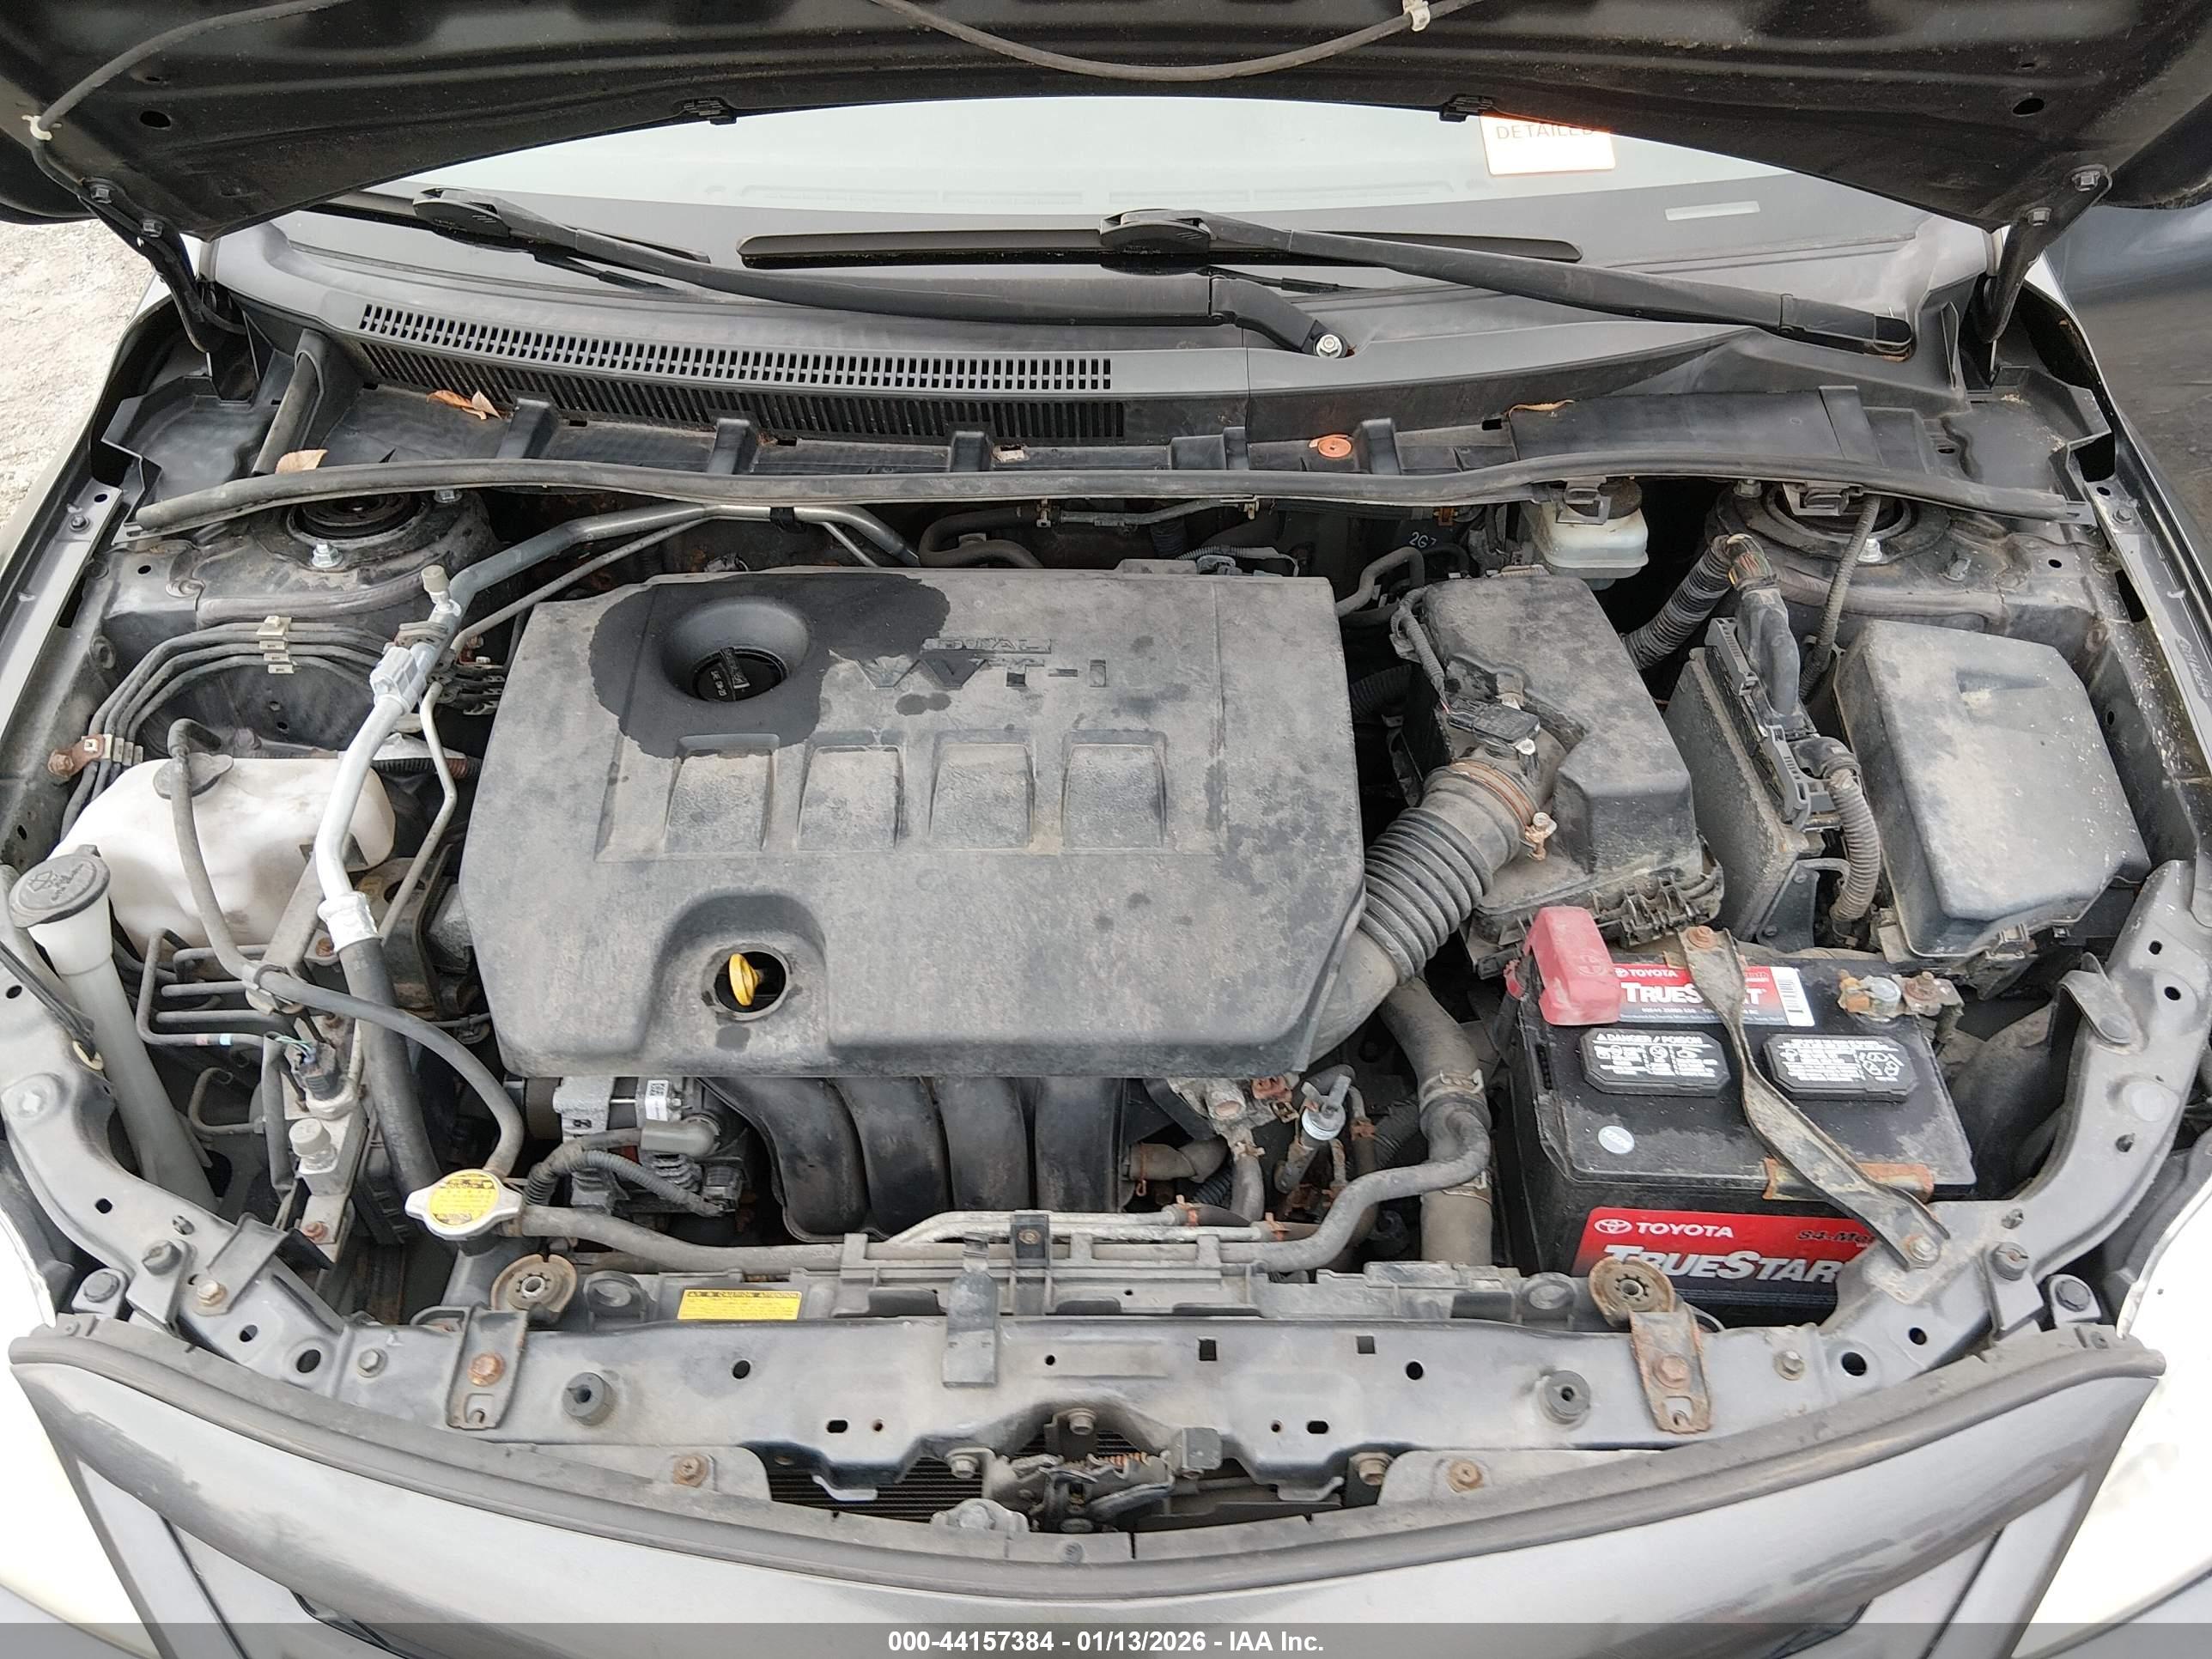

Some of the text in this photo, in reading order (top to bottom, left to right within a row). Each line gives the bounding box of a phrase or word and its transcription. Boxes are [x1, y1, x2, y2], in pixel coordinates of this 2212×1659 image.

[1497, 125, 1593, 139] DETAILED
[1629, 969, 1678, 977] TOYOTA
[1636, 1222, 1735, 1238] TOYOTA
